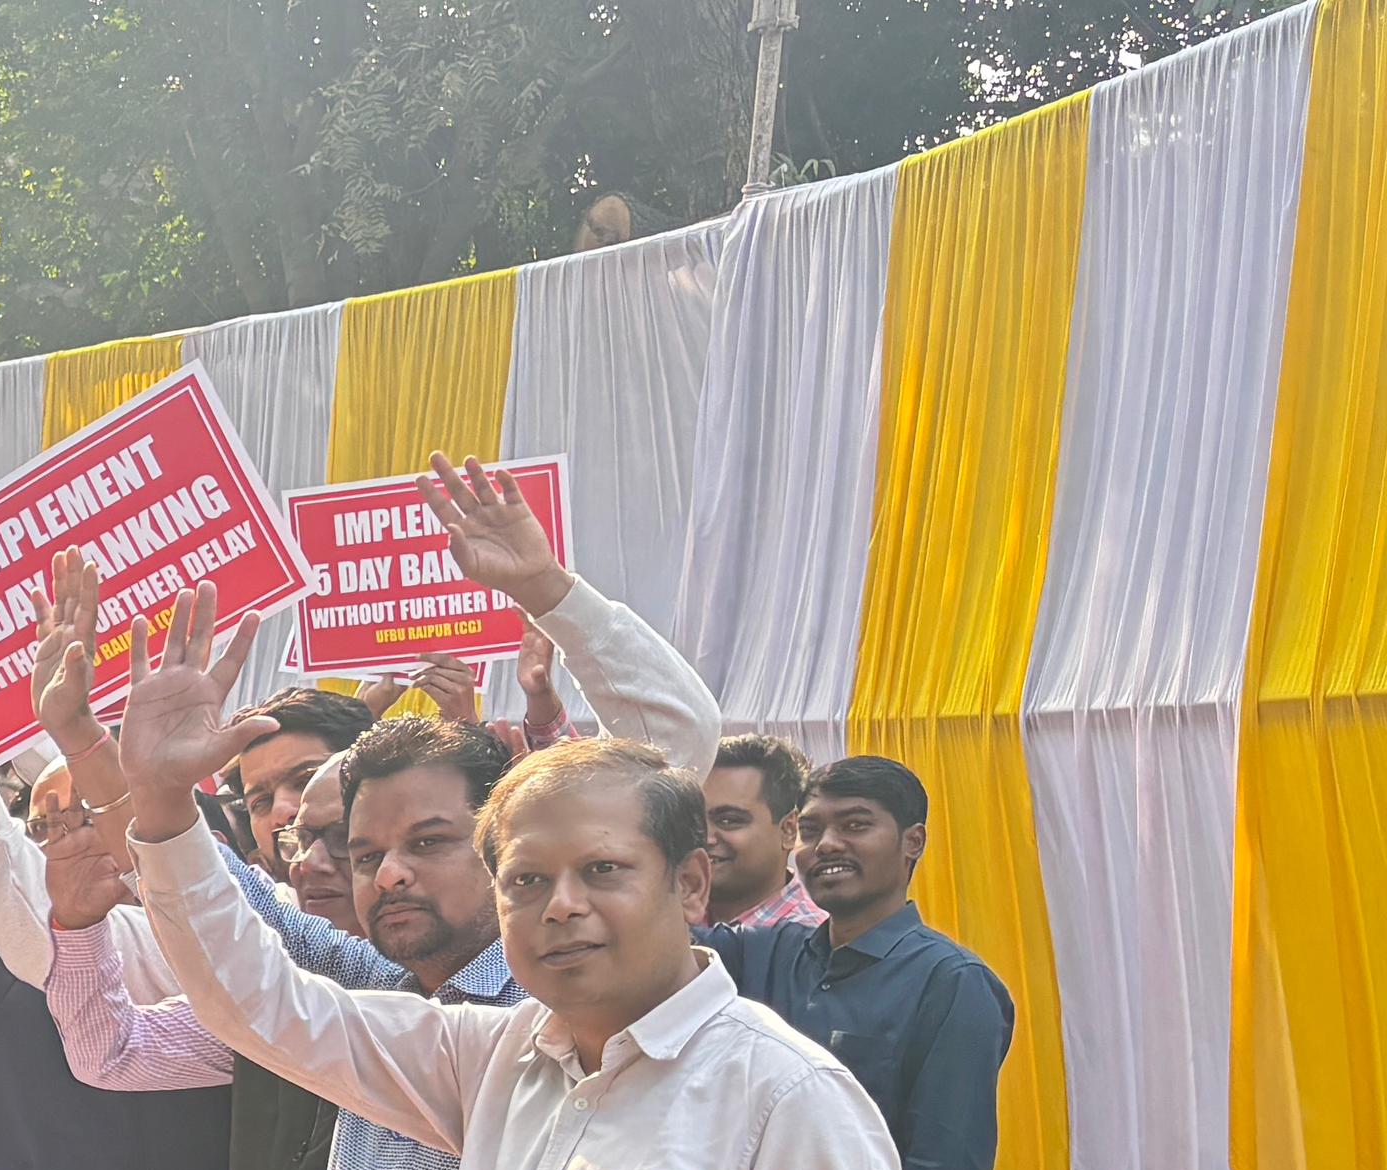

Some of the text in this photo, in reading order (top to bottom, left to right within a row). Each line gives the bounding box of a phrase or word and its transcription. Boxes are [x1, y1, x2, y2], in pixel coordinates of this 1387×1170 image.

[181, 520, 256, 581] DELAY
[338, 556, 392, 593] DAY
[311, 591, 487, 629] WITHOUT FURTHER
[408, 623, 452, 640] RAIPUR
